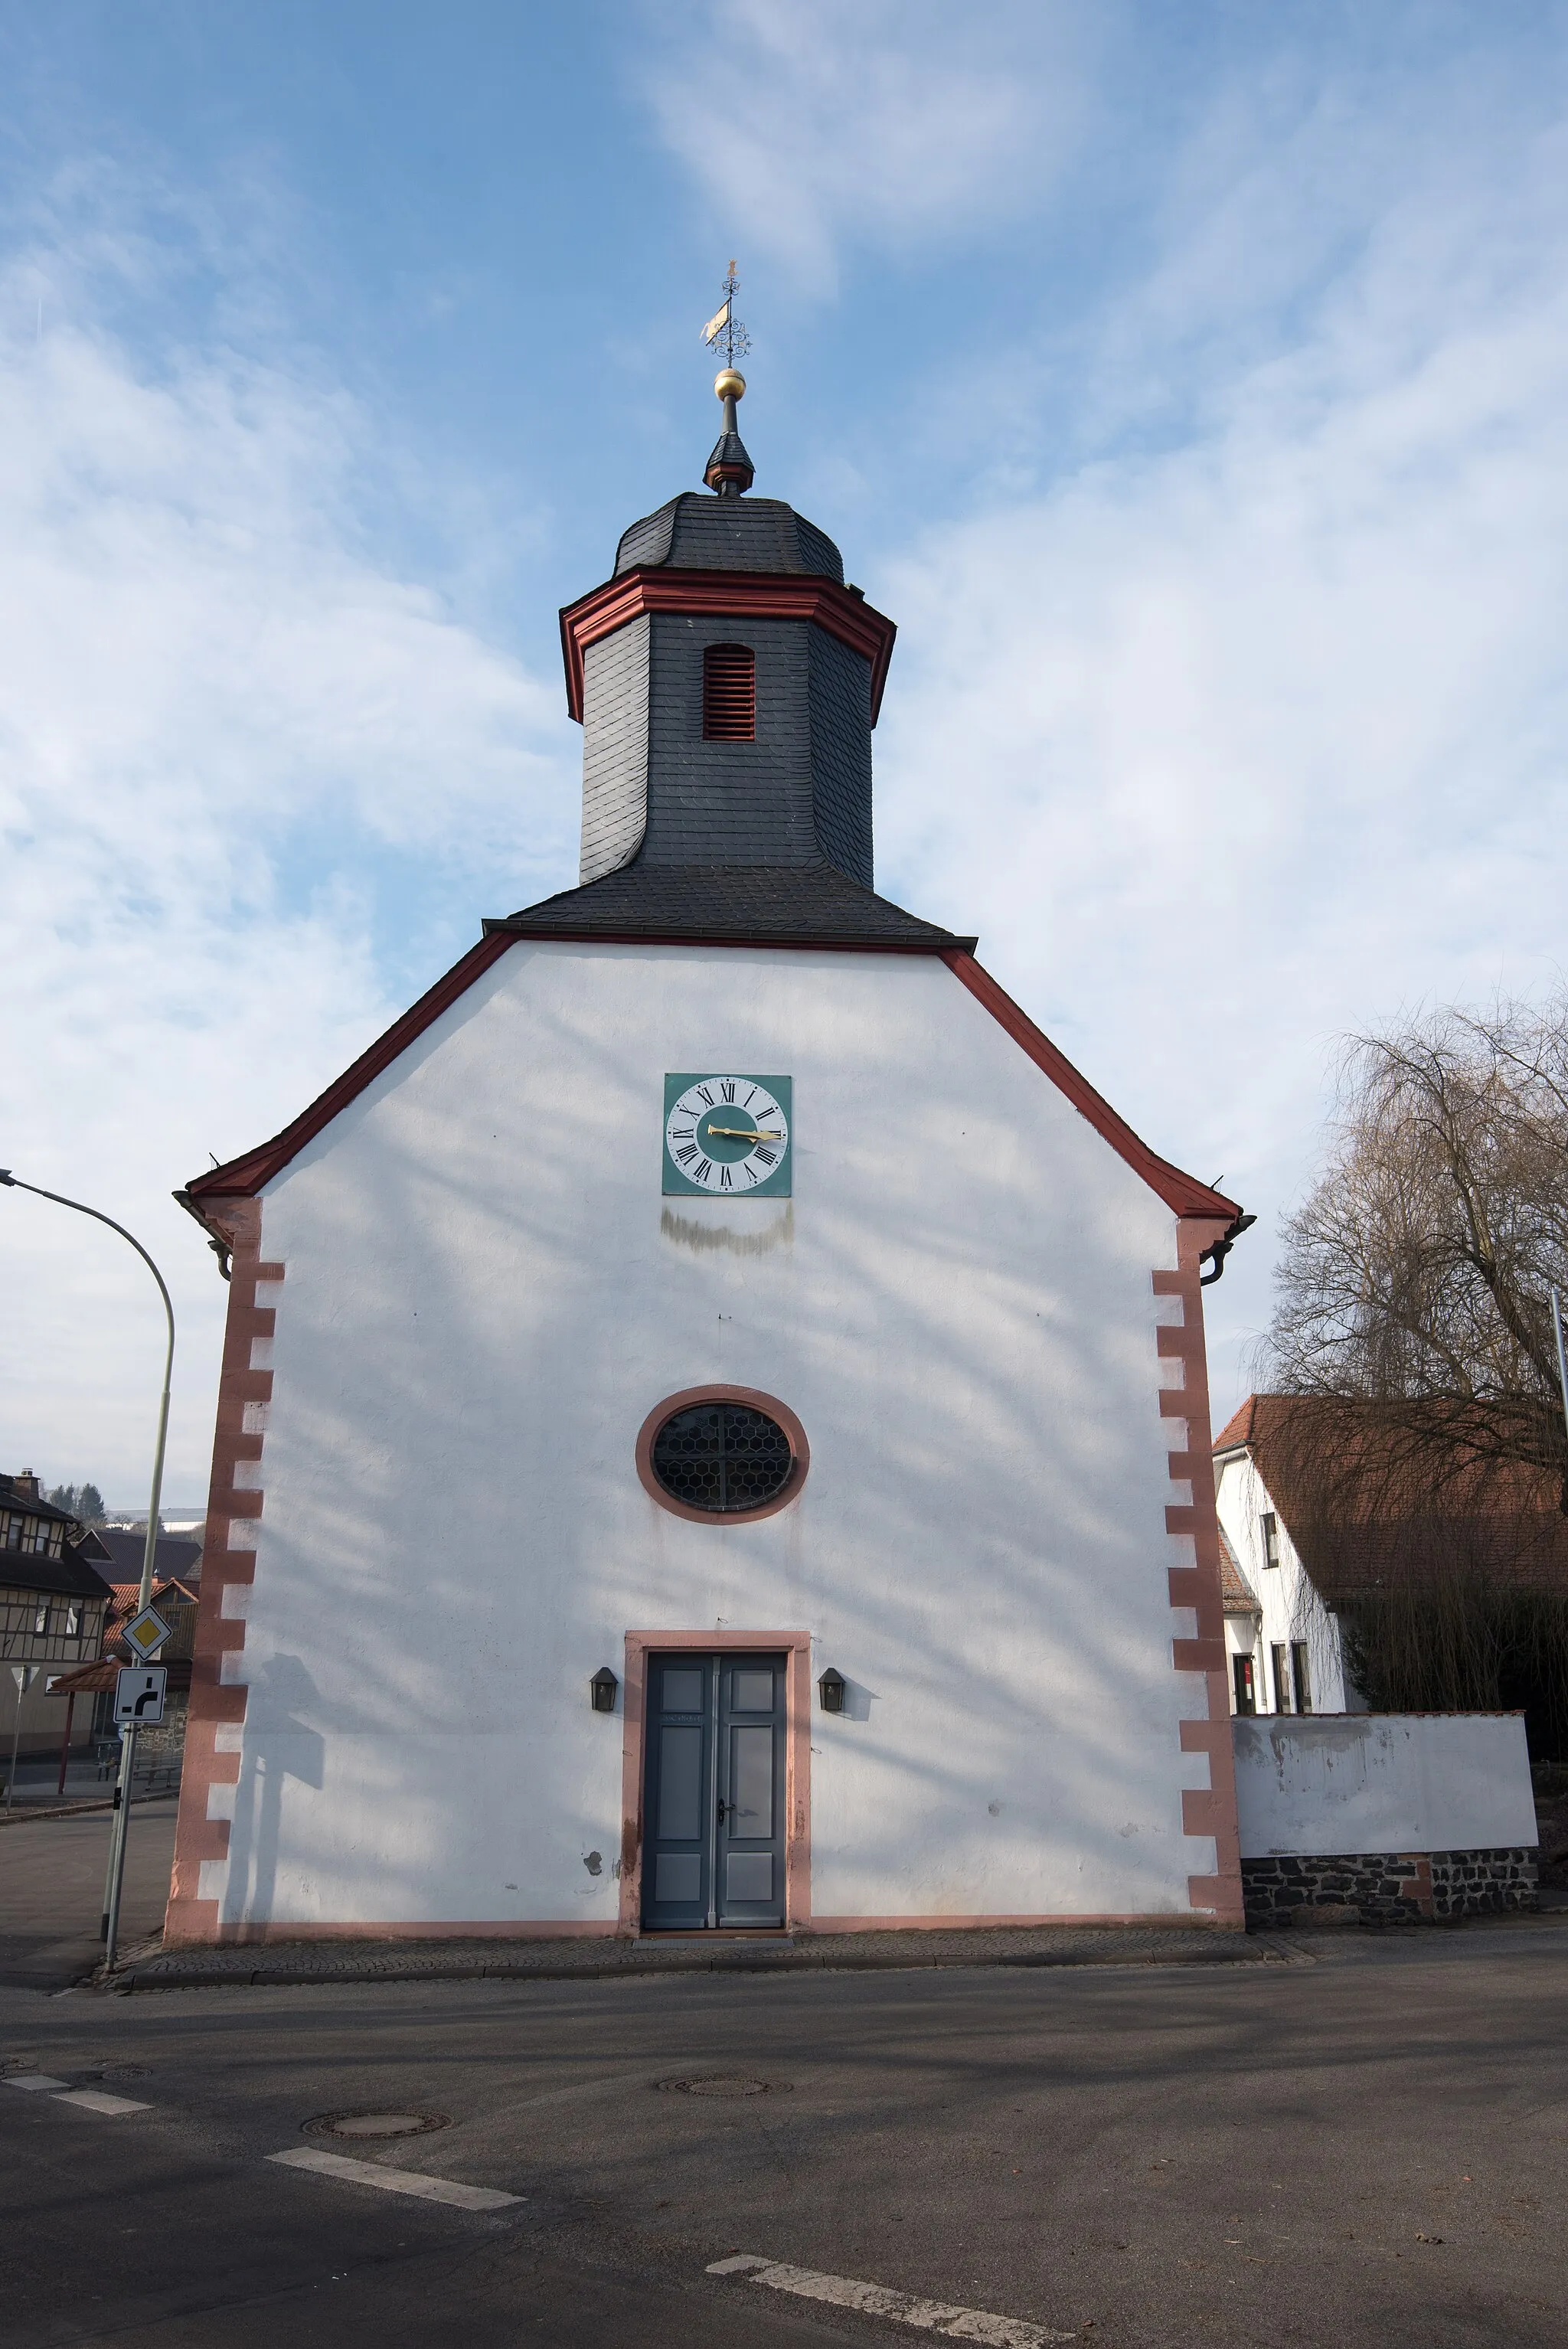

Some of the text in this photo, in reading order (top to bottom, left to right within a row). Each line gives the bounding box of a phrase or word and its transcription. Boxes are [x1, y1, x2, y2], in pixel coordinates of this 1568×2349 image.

[697, 1087, 715, 1109] XI
[720, 1083, 735, 1103] XII
[743, 1090, 756, 1107] I
[679, 1104, 700, 1120] X
[756, 1106, 776, 1120] II
[673, 1128, 694, 1139] IX
[676, 1143, 699, 1166] VIII
[753, 1146, 776, 1166] IIII
[694, 1158, 712, 1181] VII
[720, 1166, 733, 1186] VI
[743, 1162, 757, 1181] V
